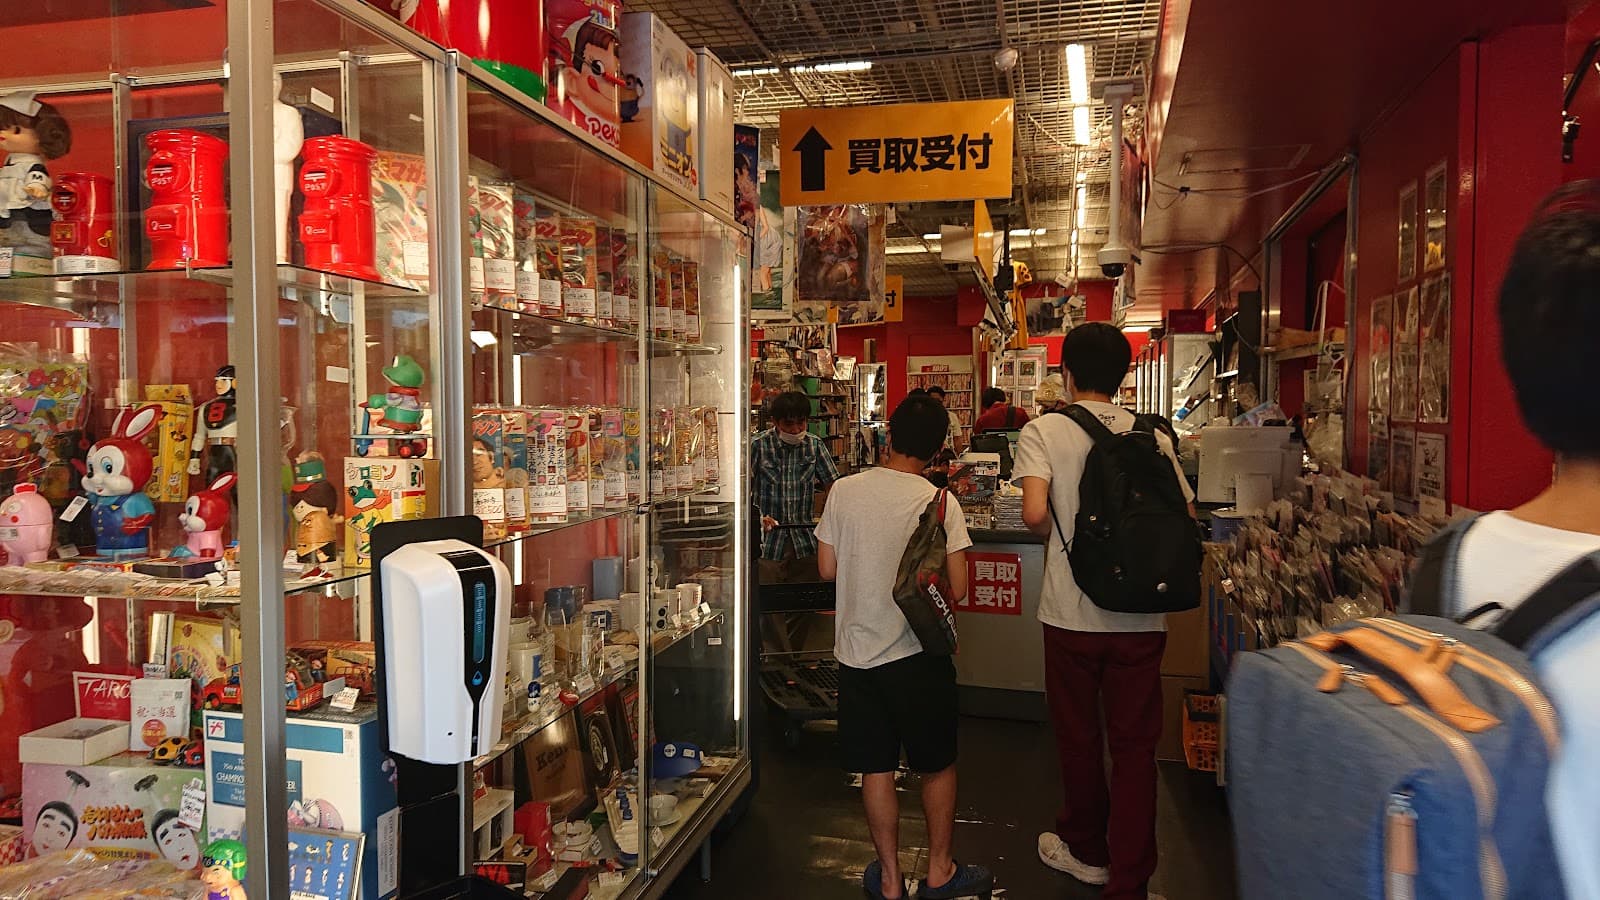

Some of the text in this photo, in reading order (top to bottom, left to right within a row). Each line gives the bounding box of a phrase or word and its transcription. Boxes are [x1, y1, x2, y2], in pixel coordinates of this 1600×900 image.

[847, 133, 993, 175] 買取受付
[151, 177, 172, 185] POST
[304, 183, 328, 192] POST
[207, 402, 226, 421] 8
[974, 560, 1017, 582] 買取
[974, 585, 1017, 608] 受付
